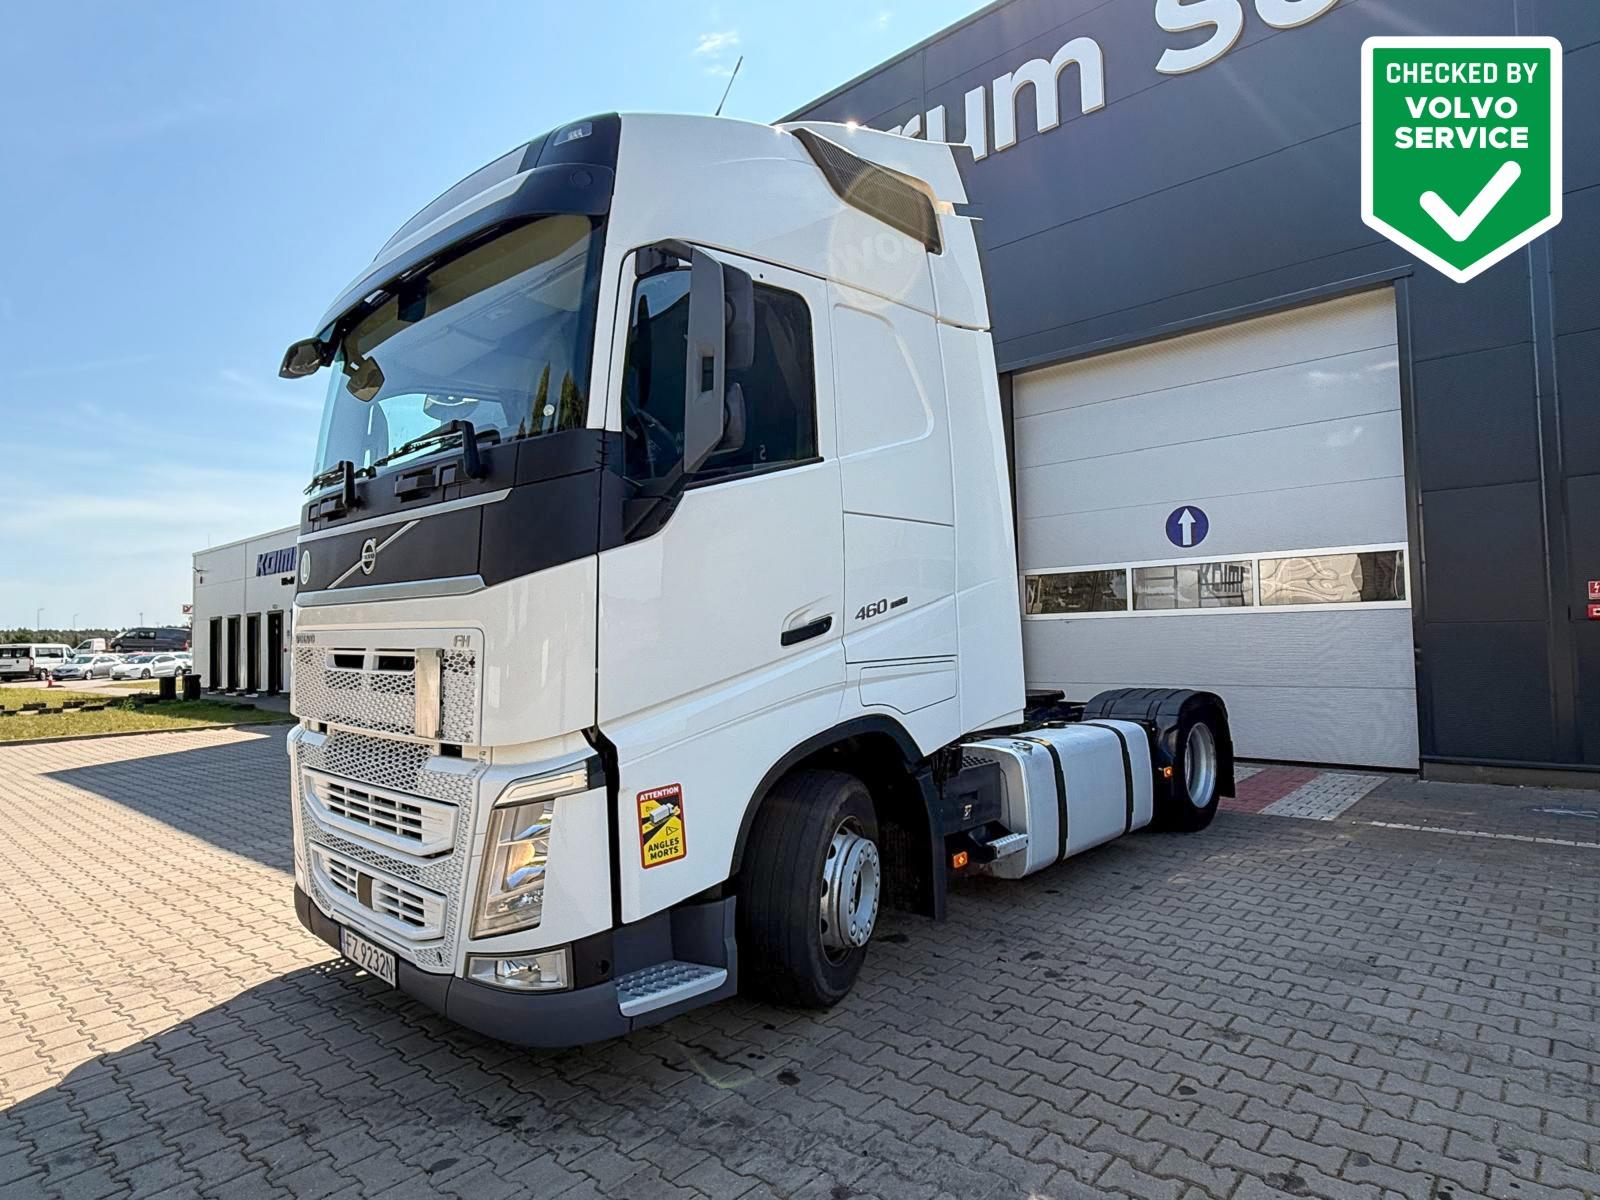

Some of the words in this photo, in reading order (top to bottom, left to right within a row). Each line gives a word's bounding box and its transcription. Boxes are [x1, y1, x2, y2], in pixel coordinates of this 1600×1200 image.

[855, 598, 888, 620] 460
[640, 786, 680, 801] ATTENTION
[648, 837, 680, 852] ANGLES
[650, 846, 679, 860] MORTS
[346, 932, 358, 960] FZ
[361, 943, 393, 981] 9232N
